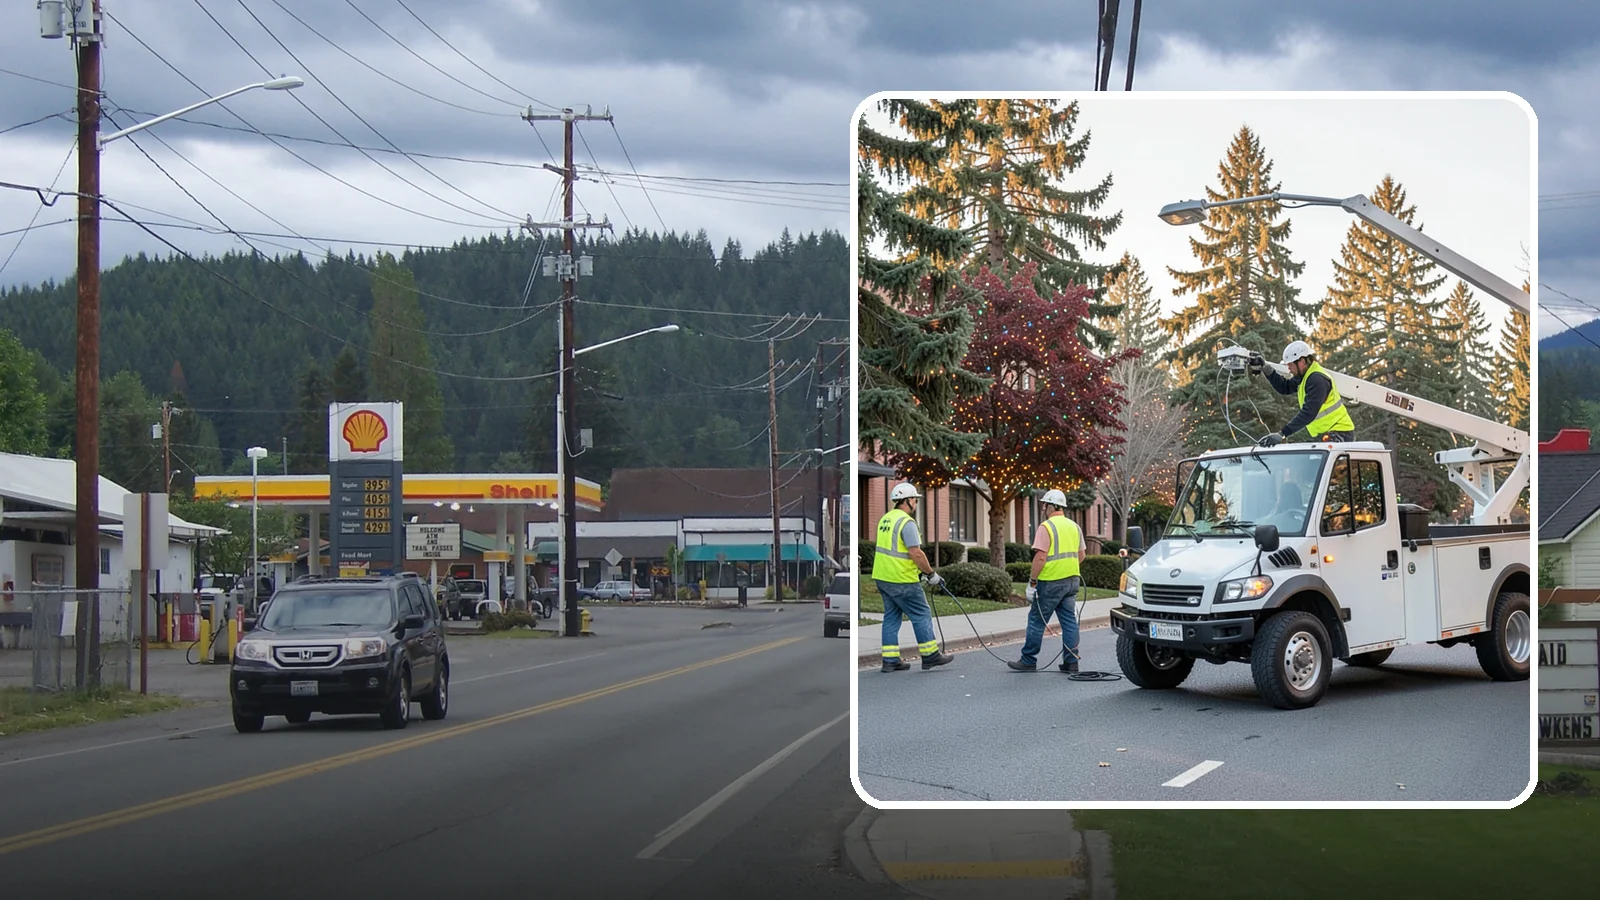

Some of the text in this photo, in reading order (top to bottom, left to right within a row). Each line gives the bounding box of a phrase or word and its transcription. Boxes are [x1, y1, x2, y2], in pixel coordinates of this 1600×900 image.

[365, 480, 384, 490] 395
[490, 484, 548, 499] Shell
[365, 494, 384, 504] 405
[365, 508, 384, 518] 415
[365, 522, 384, 532] 429
